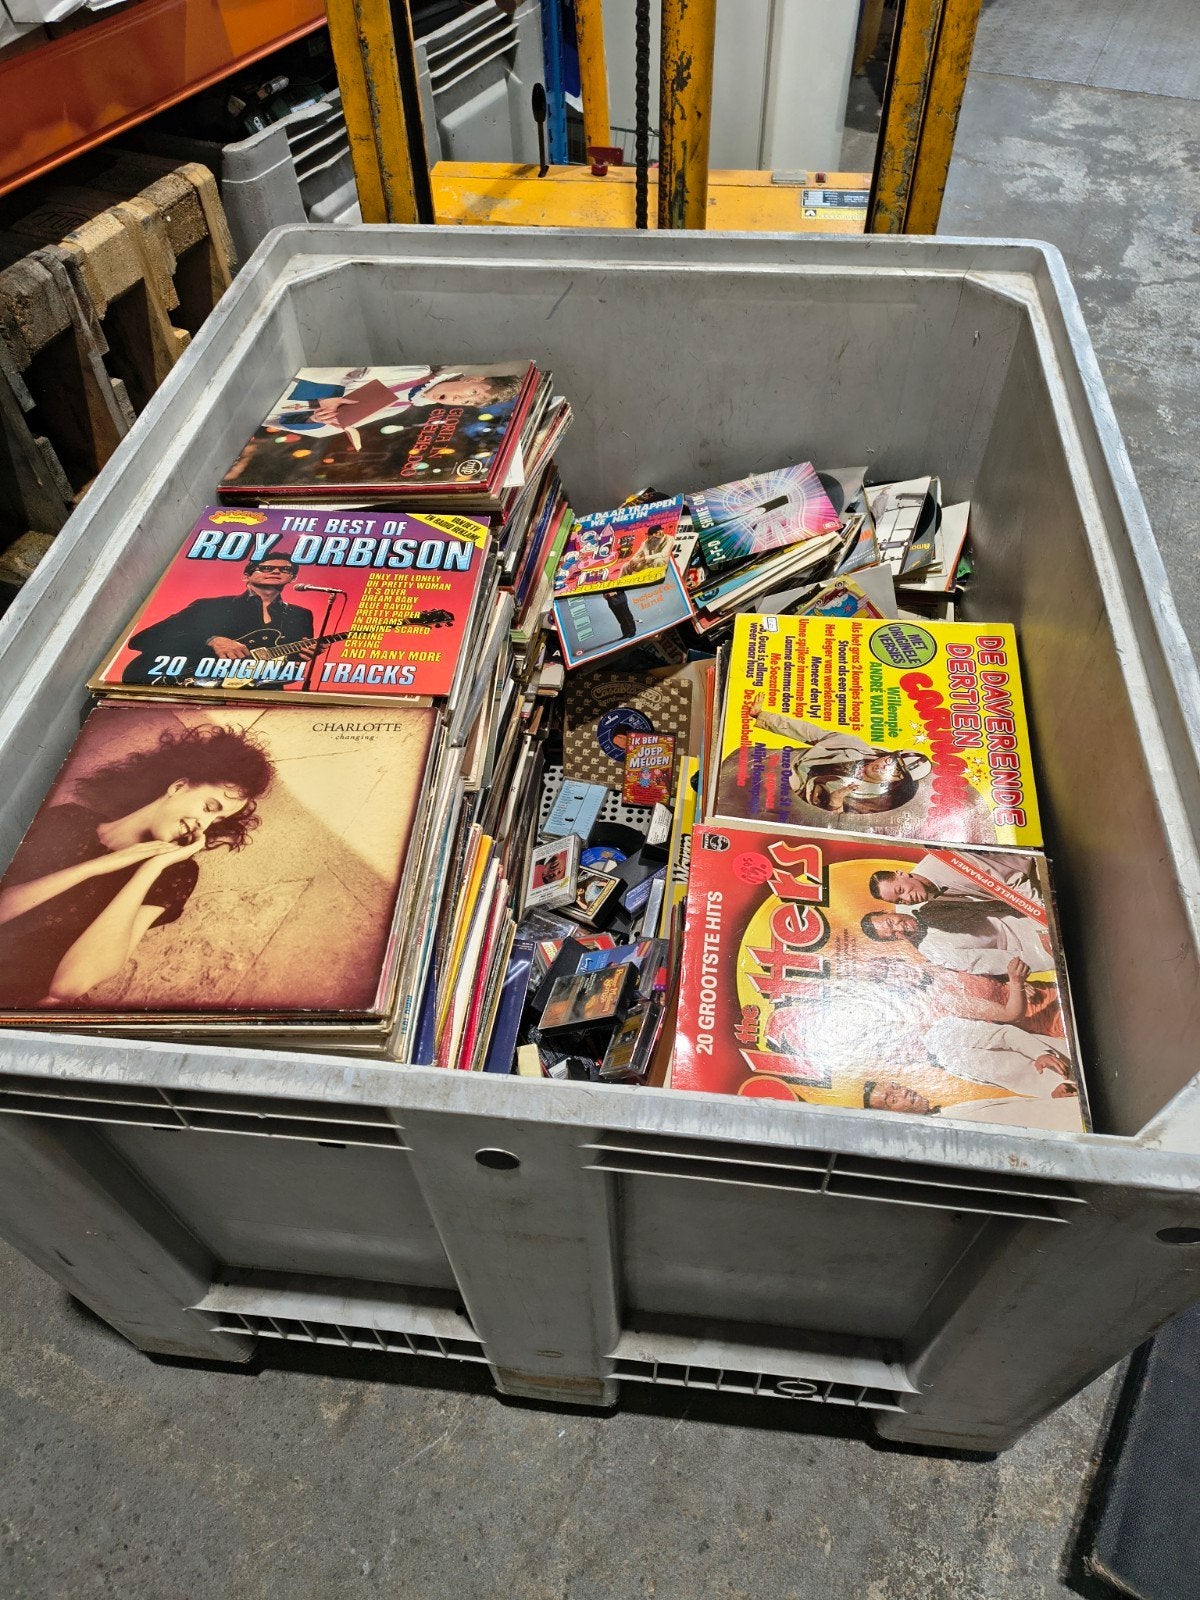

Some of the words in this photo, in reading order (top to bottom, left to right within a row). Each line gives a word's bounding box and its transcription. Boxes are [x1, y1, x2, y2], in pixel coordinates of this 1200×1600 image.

[435, 408, 463, 442] GLORIA
[595, 508, 626, 520] DAAR
[629, 497, 677, 514] TRAPPEN
[281, 516, 319, 532] THE
[324, 519, 376, 535] BEST
[382, 520, 408, 536] OF
[590, 517, 605, 527] WE
[612, 513, 636, 523] NIET
[637, 510, 648, 519] IN
[186, 530, 282, 562] ROY
[290, 533, 476, 571] ORBISON
[417, 582, 451, 590] WOMAN
[356, 609, 389, 617] PRETTY
[366, 617, 403, 625] DREAMS
[347, 632, 383, 640] FALLING
[351, 624, 391, 632] RUNNING
[395, 626, 430, 634] SCARED
[749, 623, 759, 640] weer
[800, 619, 809, 637] Unne
[826, 624, 835, 637] Het
[852, 622, 862, 633] Als
[345, 640, 380, 648] CRYING
[758, 636, 769, 653] Guus
[822, 639, 835, 657] leger
[851, 634, 862, 646] het
[878, 633, 905, 664] VERSIES
[890, 626, 921, 664] ORIGINELE
[907, 634, 929, 650] MET
[341, 649, 366, 659] AND
[370, 650, 405, 660] MANY
[408, 652, 442, 661] MORE
[747, 642, 757, 659] naar
[770, 653, 781, 665] Me
[795, 639, 809, 664] spijker
[849, 647, 860, 663] gras
[976, 636, 1007, 665] DE
[147, 655, 187, 676] 20
[194, 657, 306, 682] ORIGINAL
[321, 662, 418, 686] TRACKS
[746, 660, 758, 678] huus
[753, 663, 766, 686] allang
[811, 656, 822, 686] Meneer
[824, 660, 833, 673] van
[838, 666, 848, 676] als
[768, 666, 781, 707] Soezafoon
[838, 677, 847, 692] een
[849, 671, 864, 699] kontjes
[870, 662, 886, 693] ANDRÉ
[744, 690, 754, 700] De
[796, 674, 805, 701] munne
[810, 688, 821, 703] den
[947, 644, 982, 748] DERTIEN
[782, 693, 794, 713] doen
[824, 675, 835, 721] werkelozen
[870, 695, 884, 715] VAN
[792, 703, 807, 717] kop
[807, 705, 820, 718] Uyl
[836, 694, 850, 726] garnaal
[848, 701, 863, 722] hoog
[887, 686, 902, 739] Willempie
[312, 722, 403, 732] CHARLOTTE
[870, 717, 885, 743] DUIN
[632, 737, 640, 745] IK
[642, 736, 658, 744] BEN
[981, 671, 1026, 827] DAVERENDE
[638, 746, 663, 757] JOEP
[782, 746, 793, 768] Onze
[630, 756, 669, 768] MELOEN
[950, 857, 995, 888] OPNAMEN
[704, 890, 723, 930] HITS
[995, 884, 1042, 917] ORIGINELE
[697, 931, 721, 1030] GROOTSTE
[733, 1004, 761, 1044] the
[696, 1033, 714, 1056] 20
